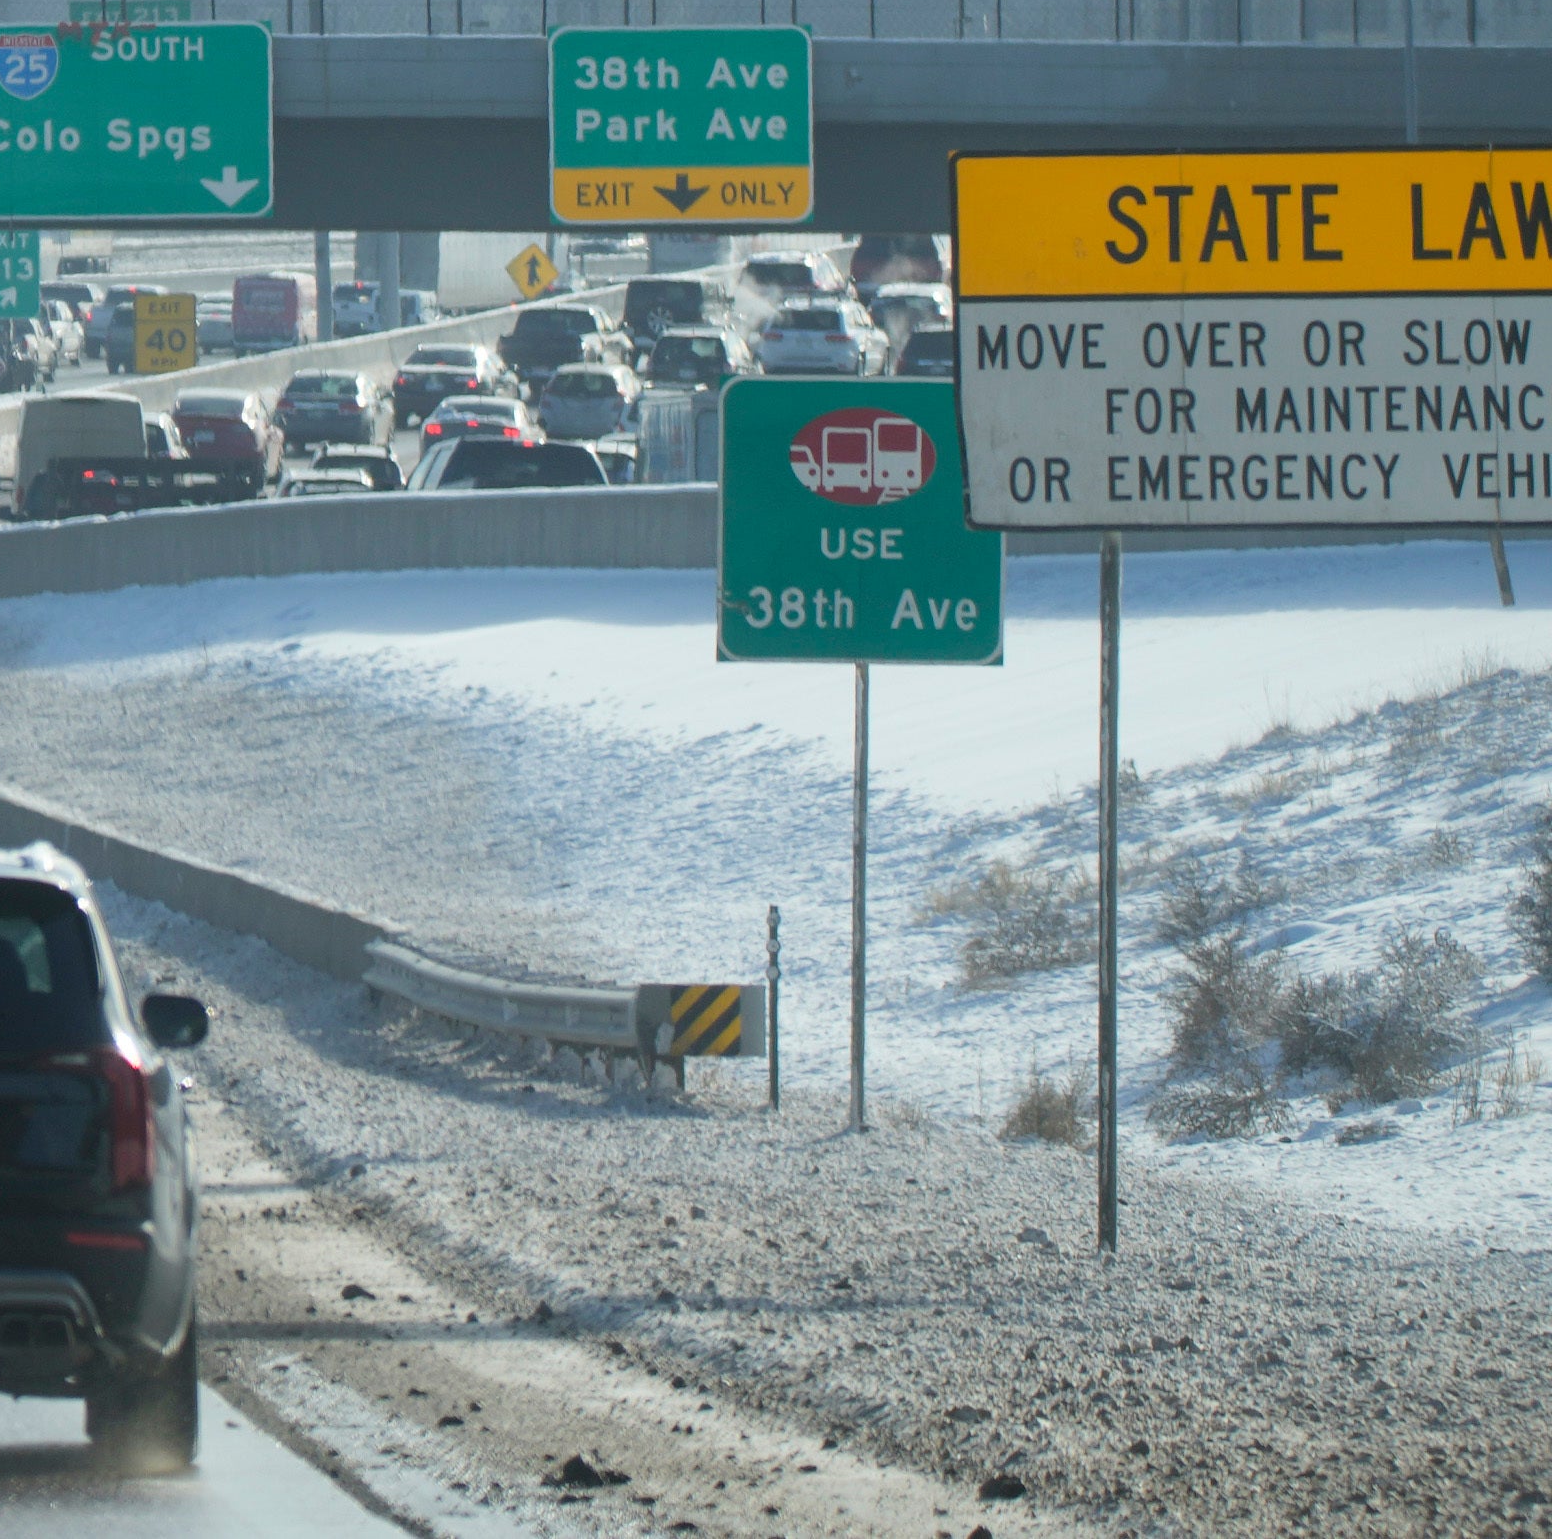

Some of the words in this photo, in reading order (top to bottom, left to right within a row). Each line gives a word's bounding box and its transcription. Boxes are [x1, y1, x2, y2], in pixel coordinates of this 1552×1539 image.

[91, 31, 204, 61] SOUTH
[6, 54, 48, 84] 25
[575, 56, 680, 89] 38th
[706, 58, 788, 89] Ave
[107, 118, 212, 160] Spgs
[576, 109, 677, 142] Park
[706, 108, 787, 141] Ave
[577, 183, 634, 207] EXIT
[721, 182, 795, 205] ONLY
[1106, 184, 1343, 264] STATE
[1410, 181, 1552, 261] LAW
[148, 301, 181, 315] EXIT
[147, 328, 186, 353] 40
[977, 323, 1107, 370] MOVE
[1143, 321, 1267, 368] OVER
[1303, 320, 1365, 367] OR
[1403, 319, 1531, 366] SLOW
[1106, 388, 1197, 435] FOR
[1009, 457, 1071, 504] OR
[1108, 454, 1400, 502] EMERGENCY
[821, 528, 903, 560] USE
[745, 586, 855, 629] 38th
[890, 588, 977, 631] Ave
